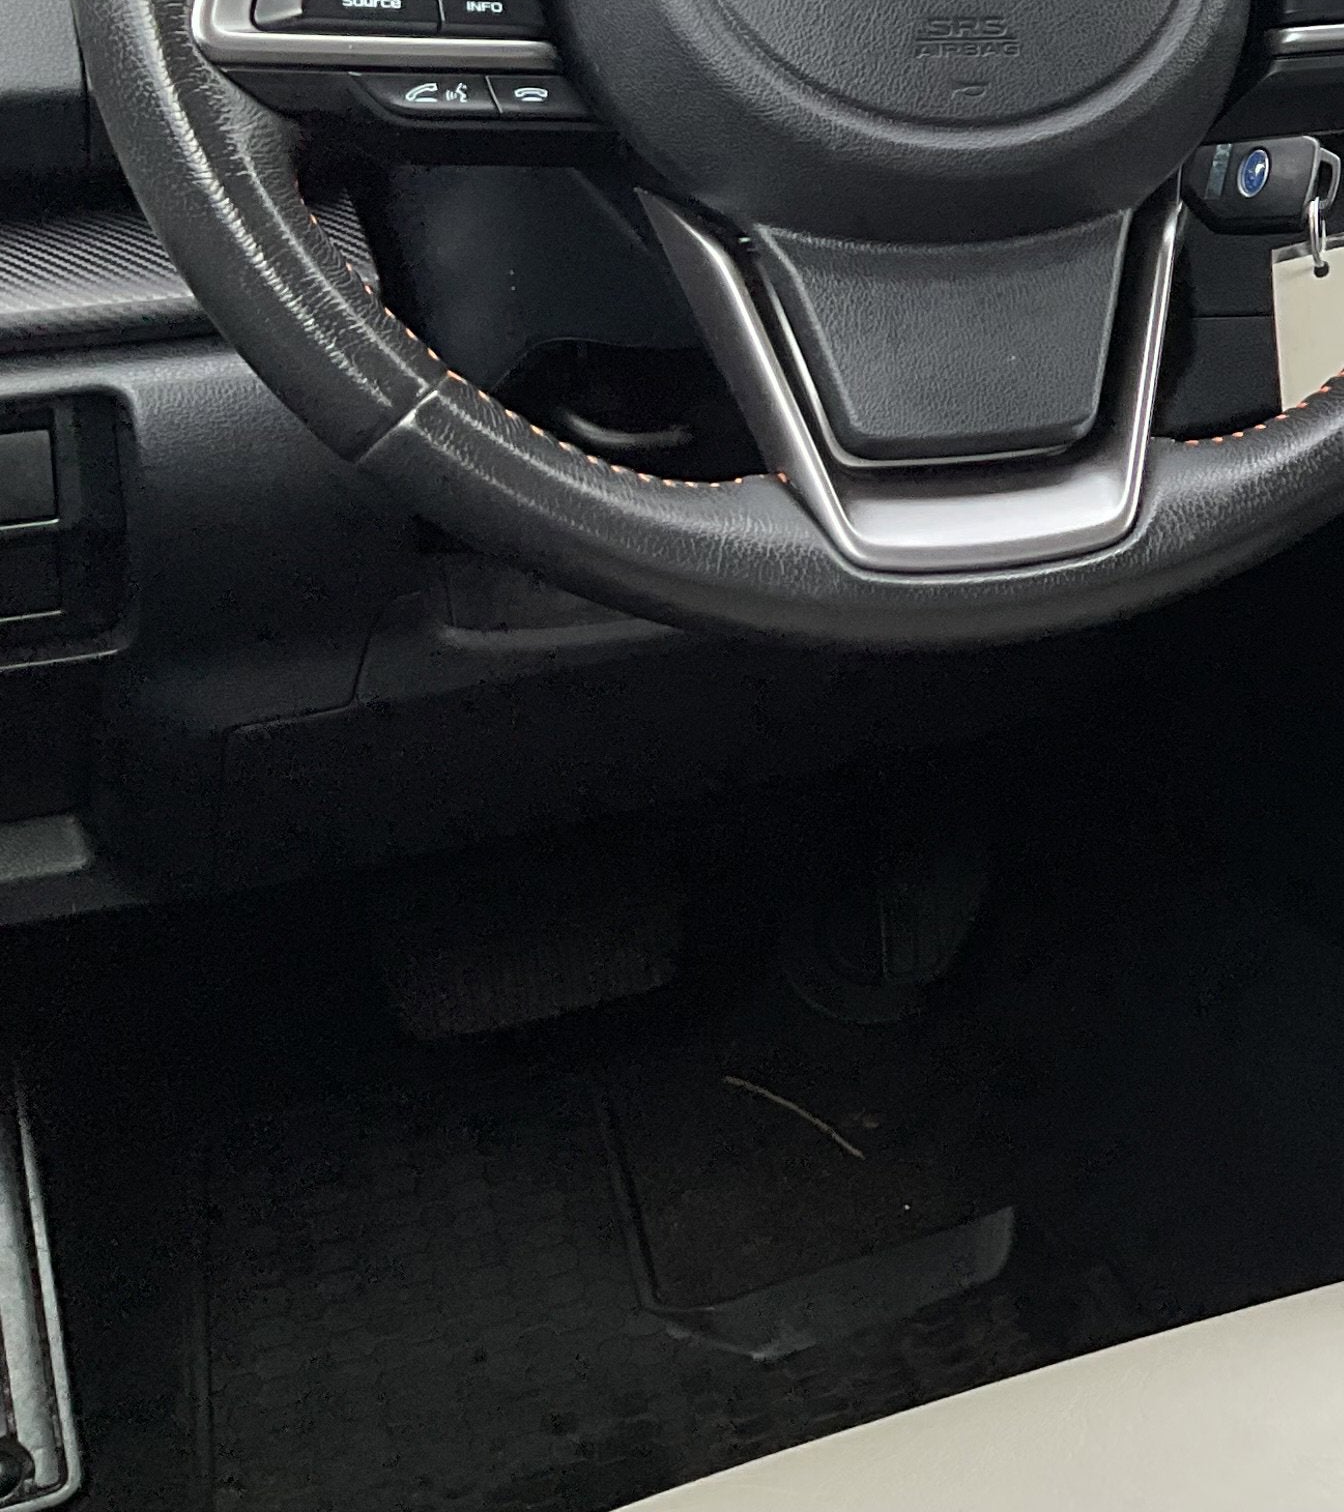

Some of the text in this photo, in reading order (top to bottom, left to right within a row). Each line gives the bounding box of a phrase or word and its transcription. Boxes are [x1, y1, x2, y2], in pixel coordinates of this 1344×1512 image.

[466, 0, 503, 13] INFO
[927, 15, 1009, 38] SRS
[915, 41, 1021, 59] AIRBAG
